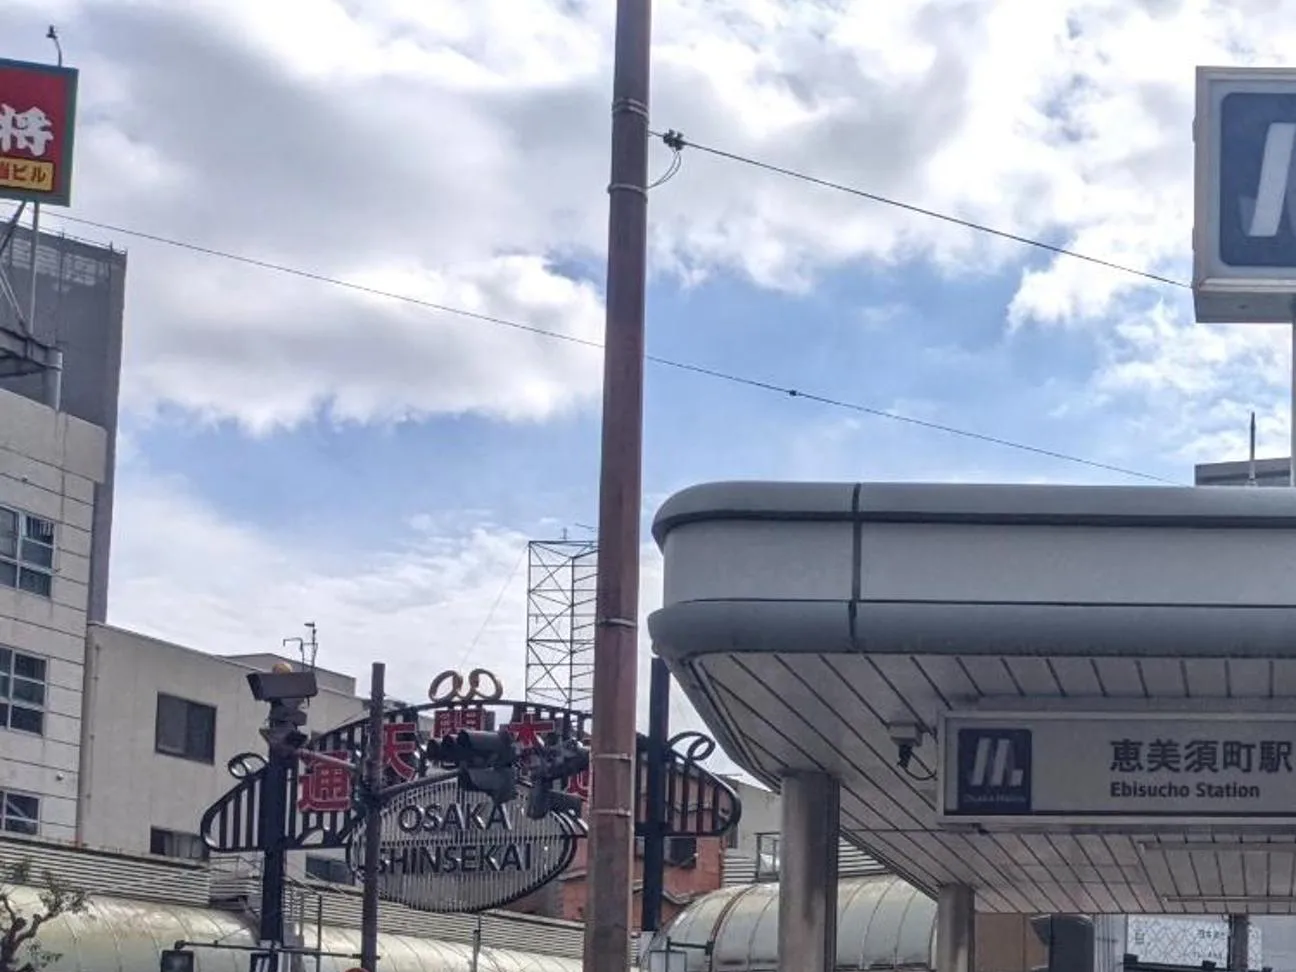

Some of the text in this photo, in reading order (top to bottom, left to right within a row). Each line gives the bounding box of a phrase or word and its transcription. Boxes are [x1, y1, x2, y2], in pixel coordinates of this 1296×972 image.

[1108, 738, 1294, 774] 恵美須町駅
[1109, 781, 1261, 799] Ebisucho Station
[398, 802, 512, 834] OSAKA
[376, 842, 532, 875] SHINSEKAI
